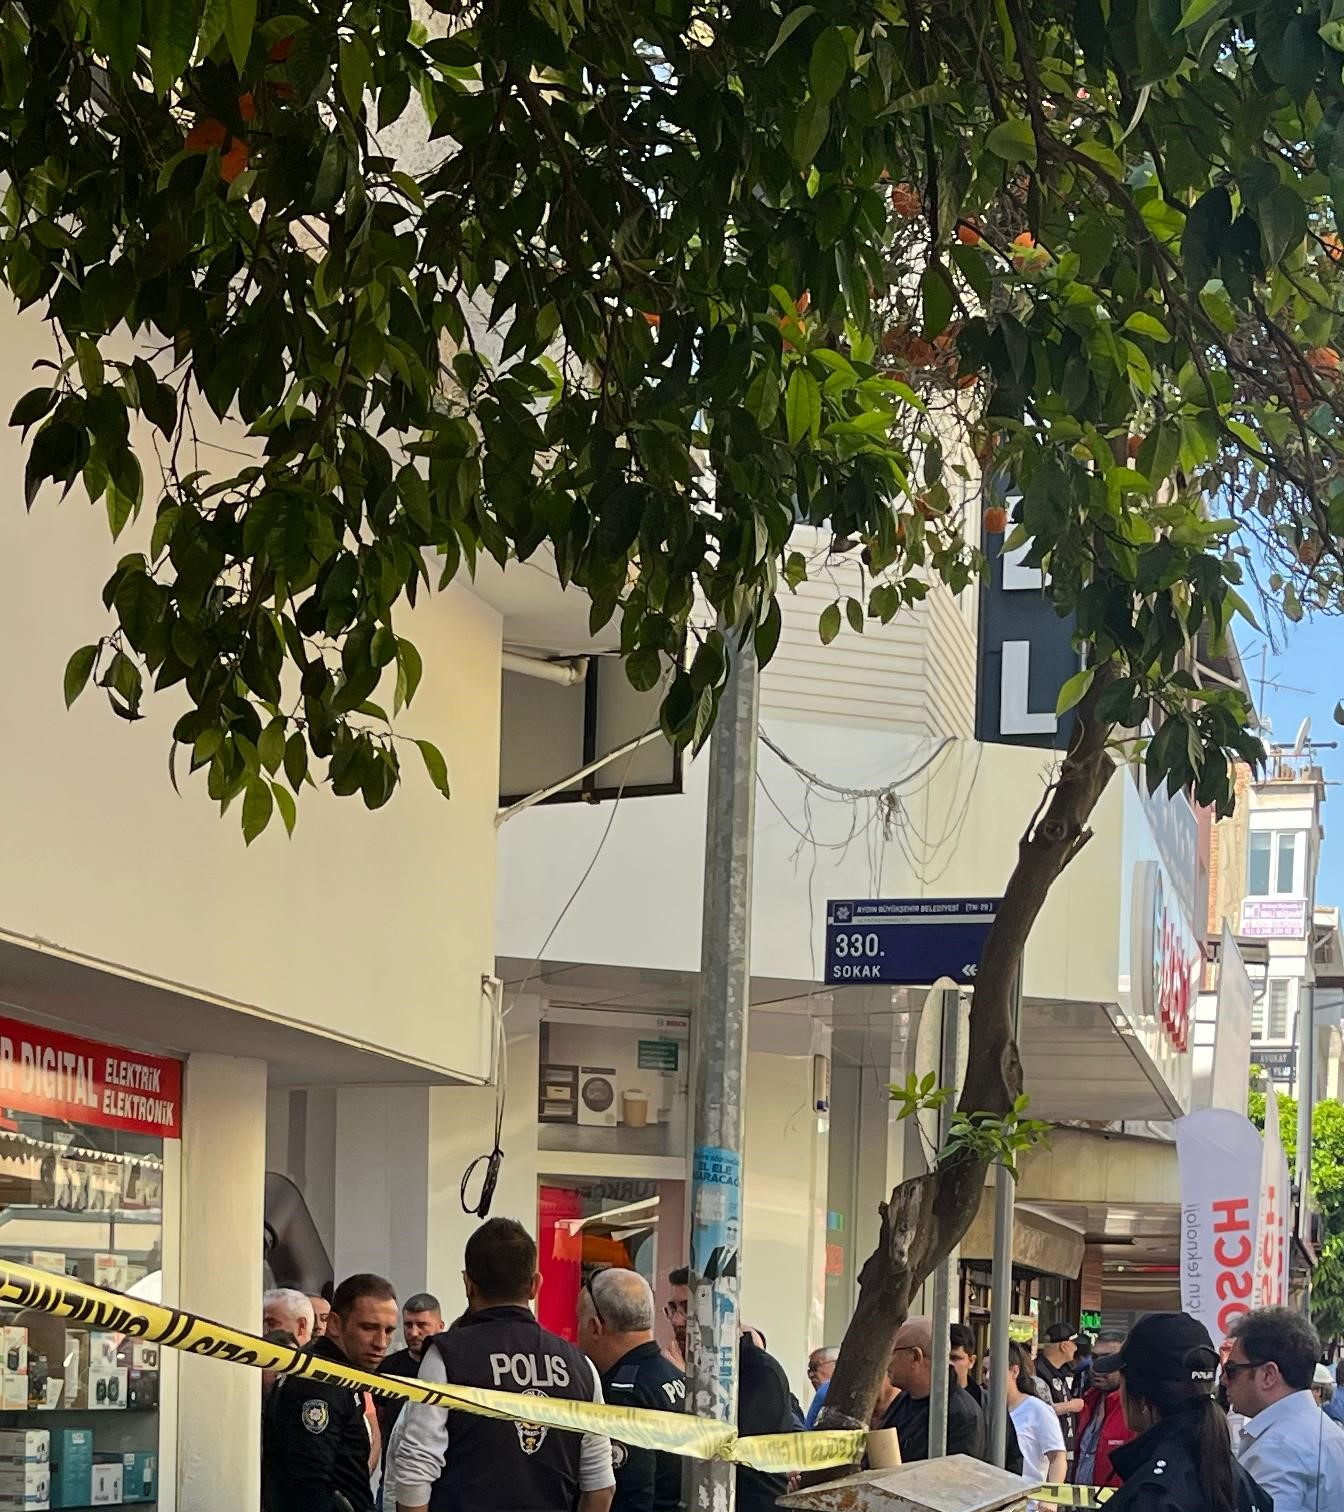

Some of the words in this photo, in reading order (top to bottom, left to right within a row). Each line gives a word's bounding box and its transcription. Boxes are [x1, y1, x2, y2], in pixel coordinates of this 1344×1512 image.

[835, 933, 885, 958] 330.
[833, 965, 881, 978] SOKAK
[21, 1041, 98, 1108] DIGITAL
[105, 1057, 161, 1093] ELEKTRİK
[103, 1089, 175, 1127] ELEKTRONİK
[489, 1353, 570, 1388] POLIS
